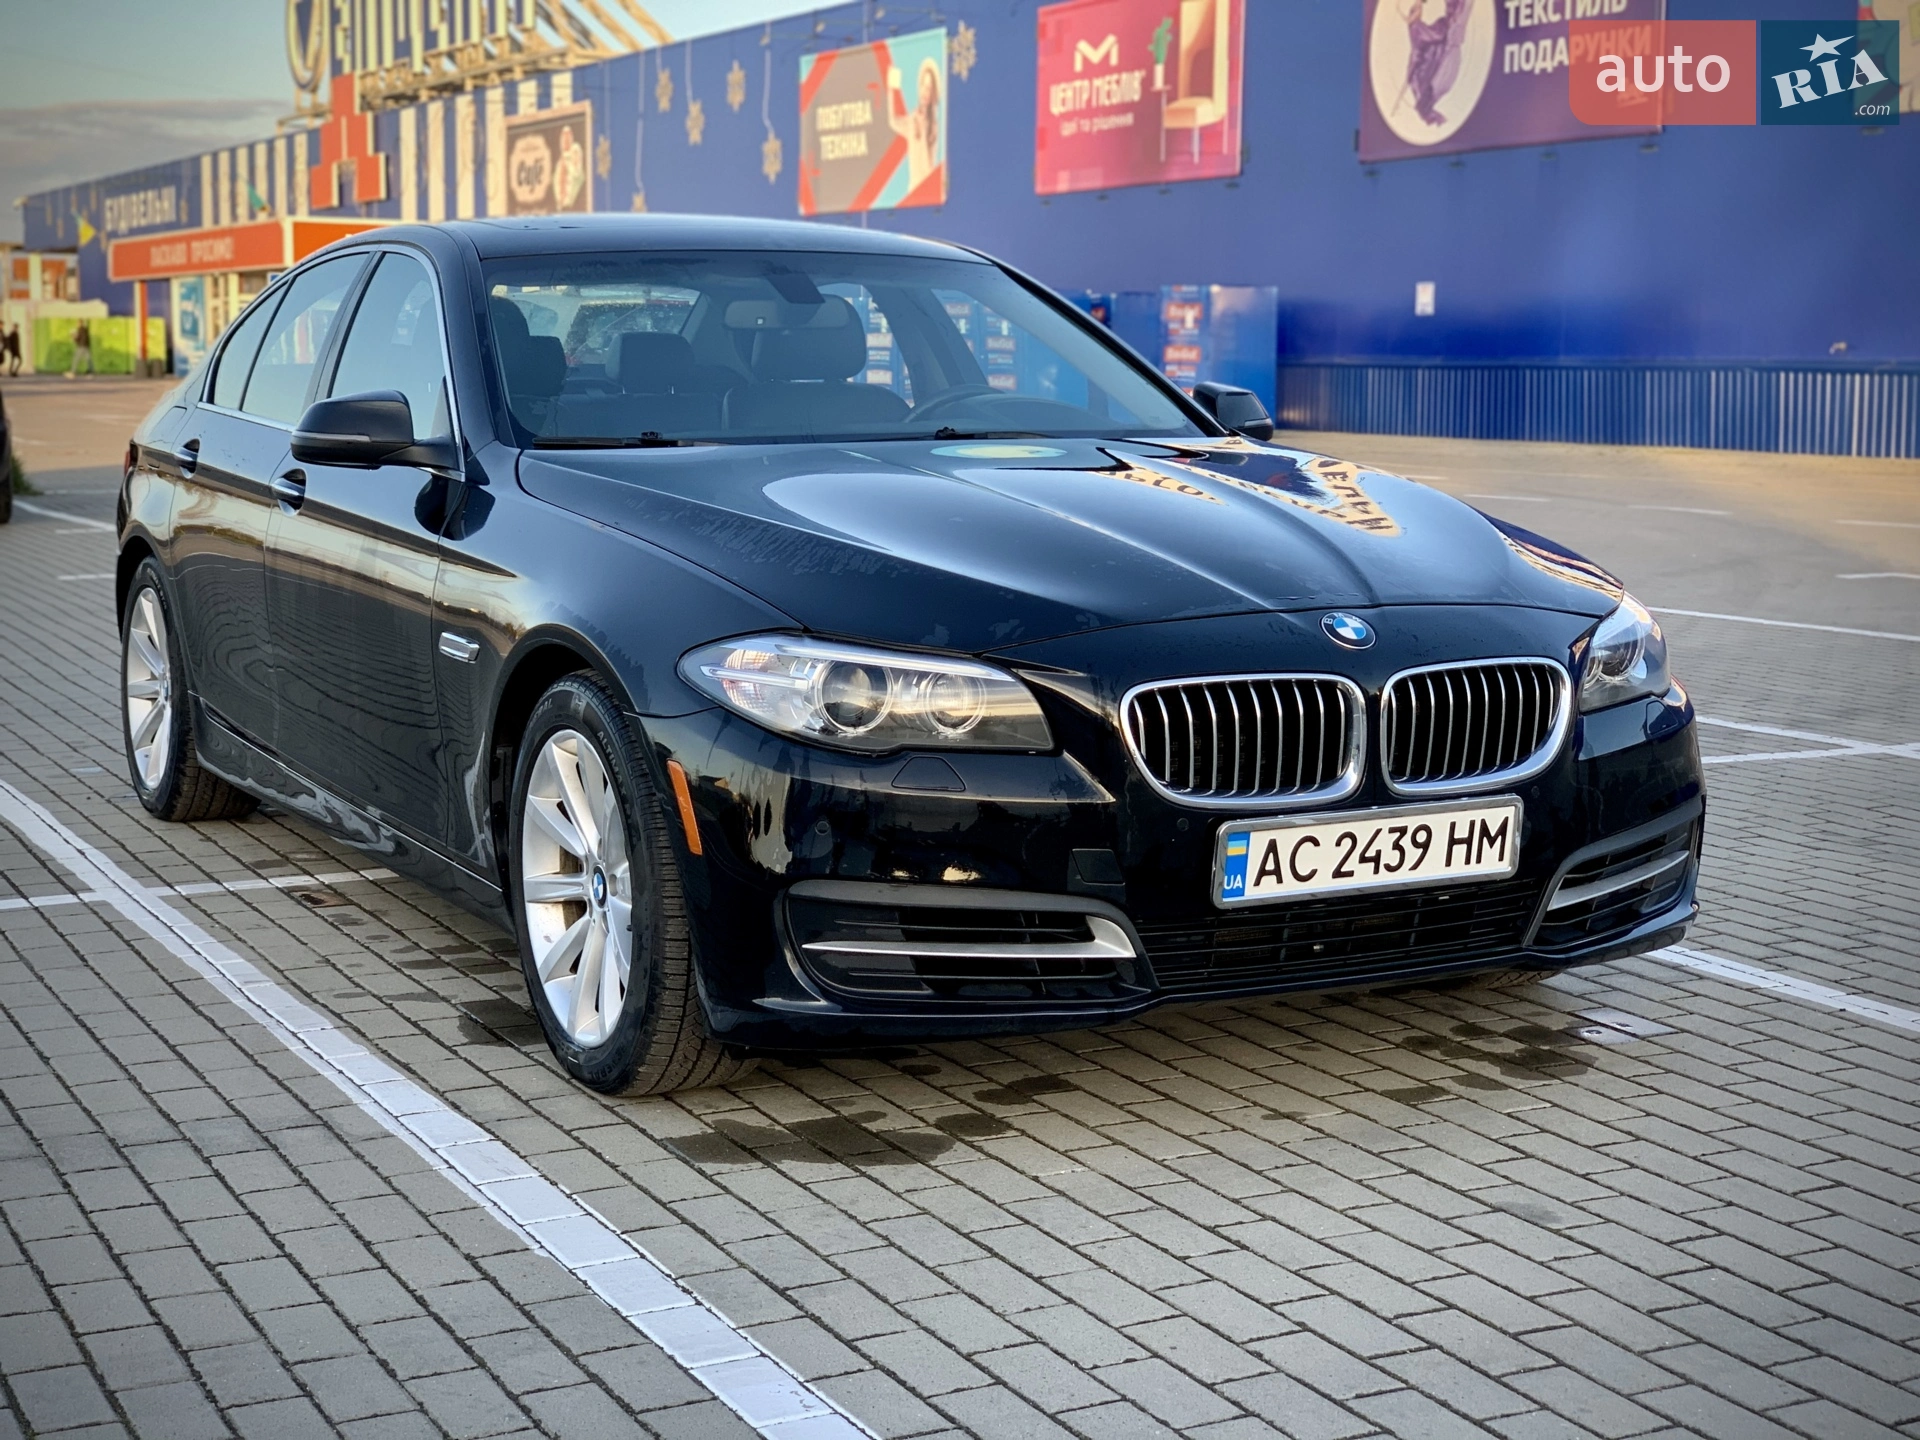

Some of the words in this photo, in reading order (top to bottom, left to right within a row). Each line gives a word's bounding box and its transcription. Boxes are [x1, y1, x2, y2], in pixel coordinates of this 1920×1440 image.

[1253, 835, 1321, 887] AC
[1331, 823, 1433, 880] 2439
[1444, 816, 1510, 868] HM
[1223, 873, 1244, 890] UA
